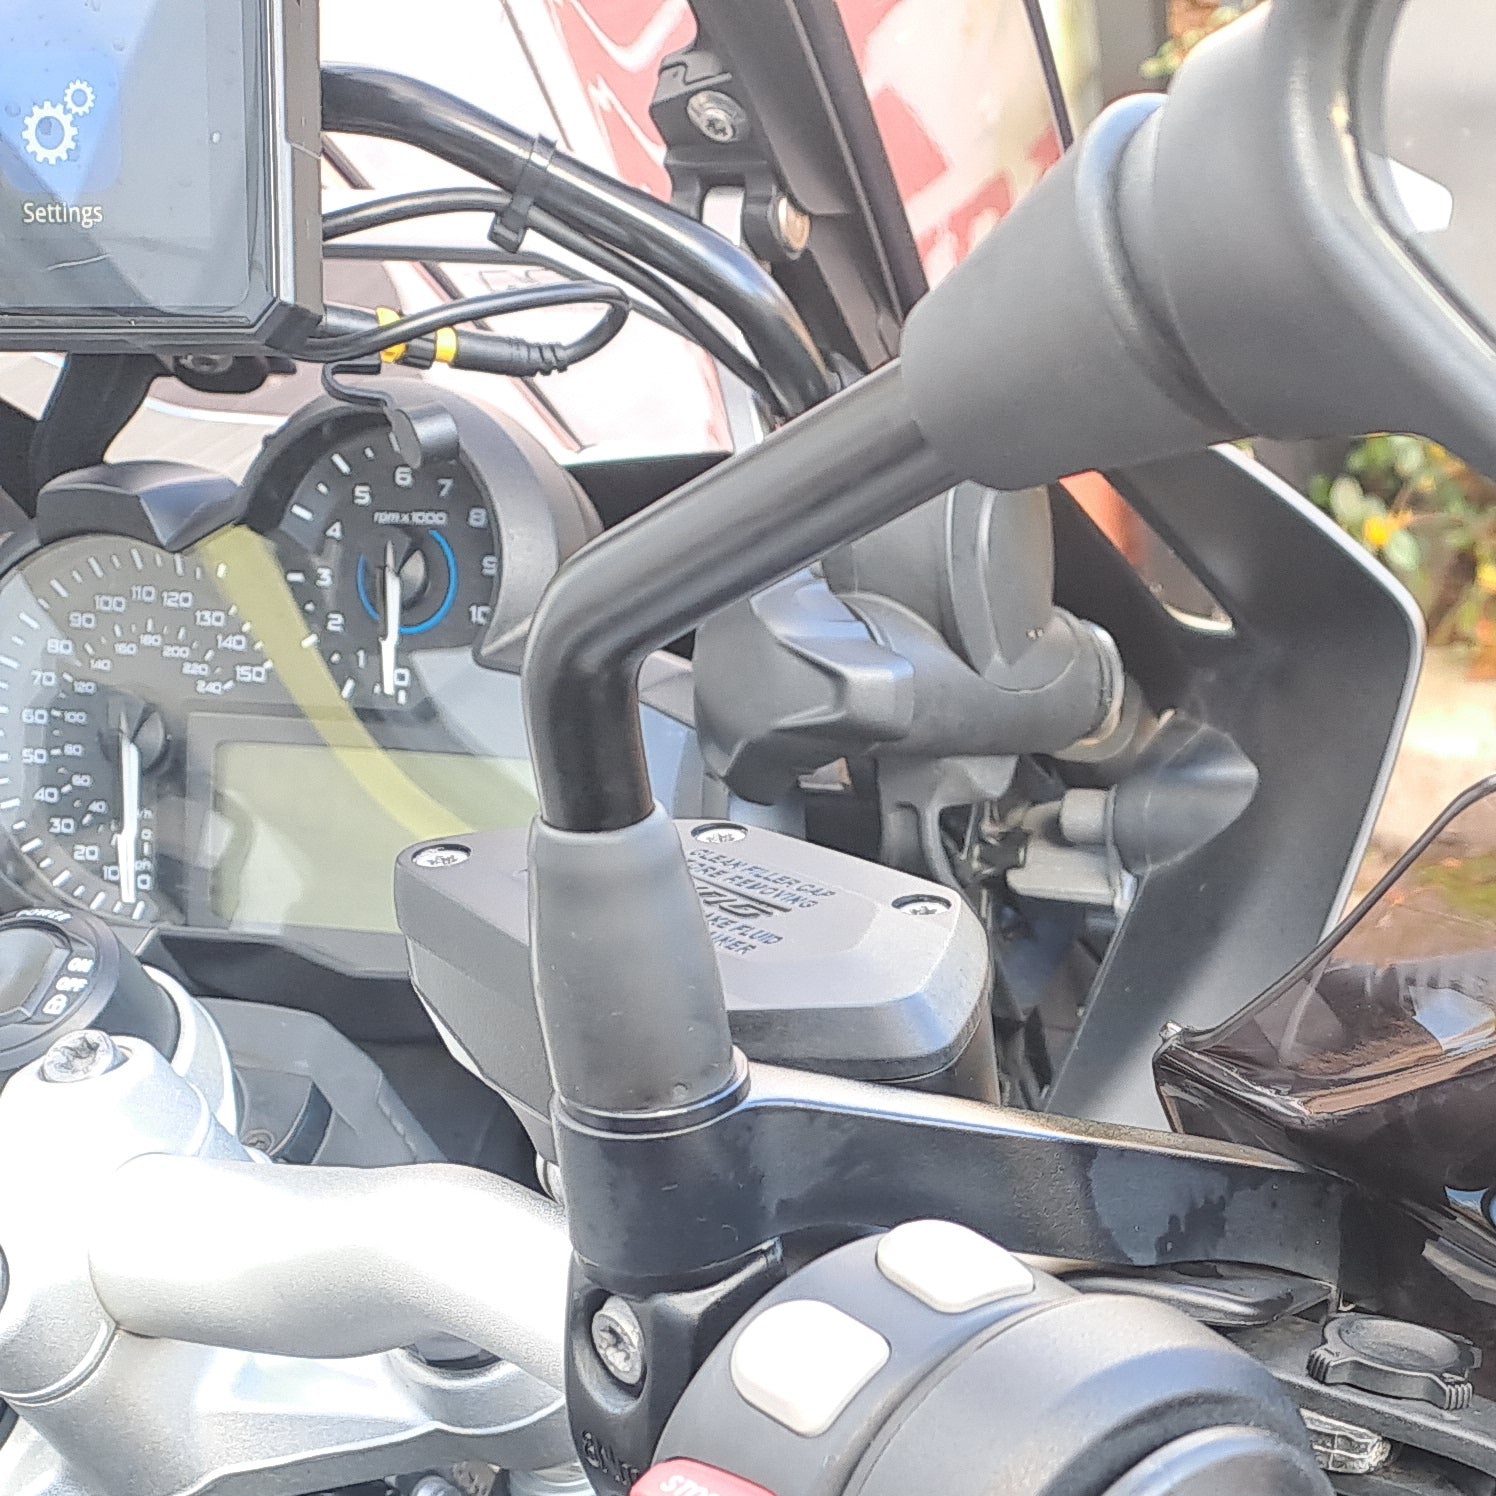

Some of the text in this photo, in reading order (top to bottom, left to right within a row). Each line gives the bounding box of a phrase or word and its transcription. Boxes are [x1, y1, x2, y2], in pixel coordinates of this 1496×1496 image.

[23, 202, 103, 228] Settings
[394, 466, 413, 487] 6
[353, 485, 371, 506] 5
[437, 479, 454, 497] 7
[468, 507, 488, 527] 8
[325, 521, 343, 540] 4
[315, 567, 333, 587] 3
[131, 585, 156, 602] 110
[162, 591, 193, 608] 120
[95, 595, 126, 612] 100
[69, 612, 96, 628] 90
[195, 610, 226, 627] 130
[326, 613, 344, 632] 2
[217, 634, 246, 650] 140
[357, 650, 366, 668] 1
[31, 671, 56, 686] 70
[235, 665, 268, 682] 150
[394, 667, 411, 687] 0
[22, 708, 48, 724] 60
[22, 748, 48, 764] 50
[34, 787, 59, 803] 40
[49, 817, 75, 834] 30
[73, 845, 99, 862] 20
[103, 865, 120, 881] 10
[689, 850, 836, 897] CLEAN FILLER CAP
[137, 874, 153, 890] 0
[724, 875, 819, 909] REMOVING
[729, 924, 784, 945] FLUID
